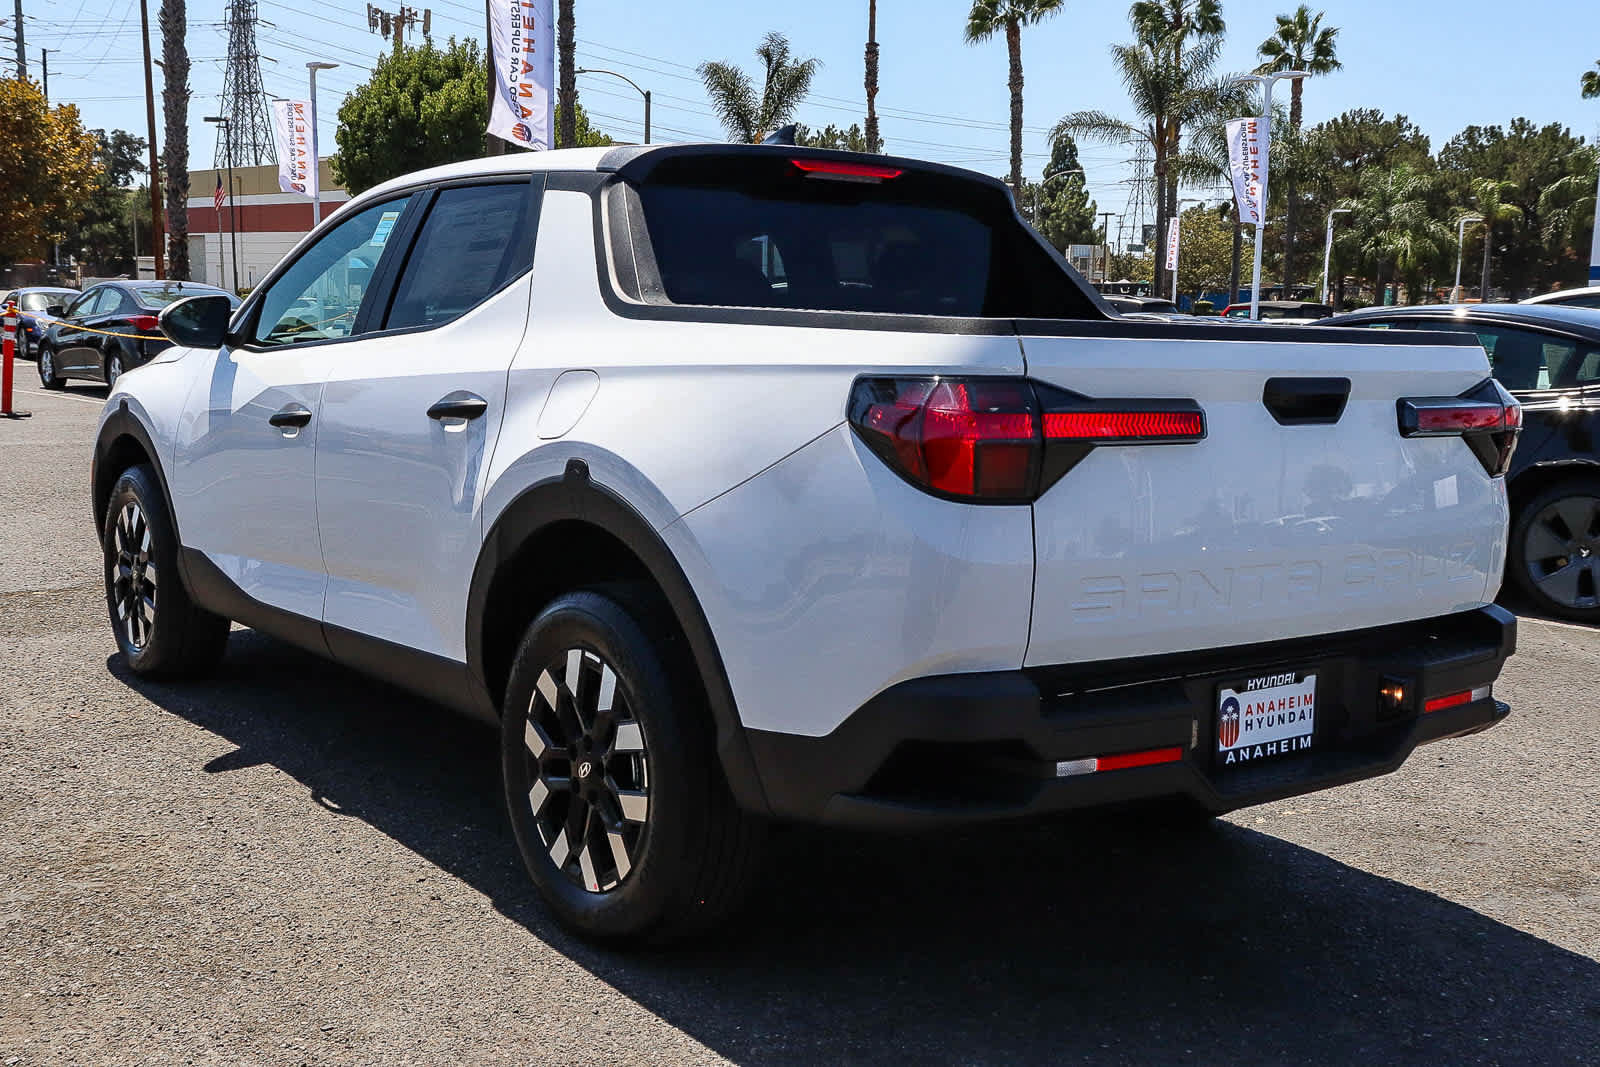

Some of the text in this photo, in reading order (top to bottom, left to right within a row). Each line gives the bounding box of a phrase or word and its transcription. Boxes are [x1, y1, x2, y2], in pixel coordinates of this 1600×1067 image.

[1247, 672, 1296, 691] HYUNDAI
[1245, 693, 1313, 717] ANAHEIM
[1244, 708, 1313, 732] HYUNDAI
[1225, 735, 1312, 765] ANAHEIM
